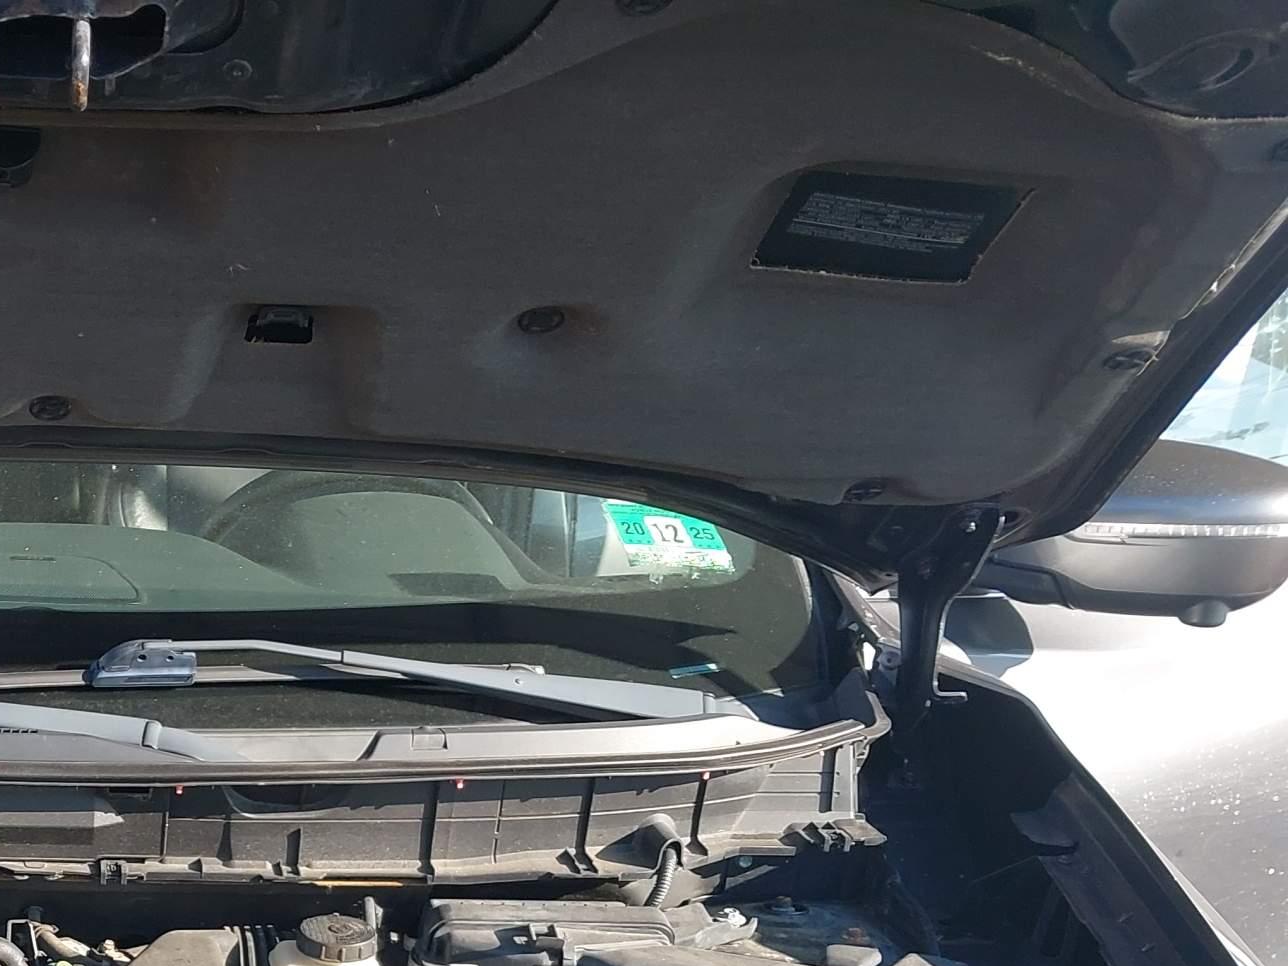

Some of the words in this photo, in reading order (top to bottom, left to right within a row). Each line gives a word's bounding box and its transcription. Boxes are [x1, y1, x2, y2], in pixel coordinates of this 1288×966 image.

[621, 521, 645, 536] 20
[650, 523, 684, 543] 12
[690, 527, 715, 540] 25
